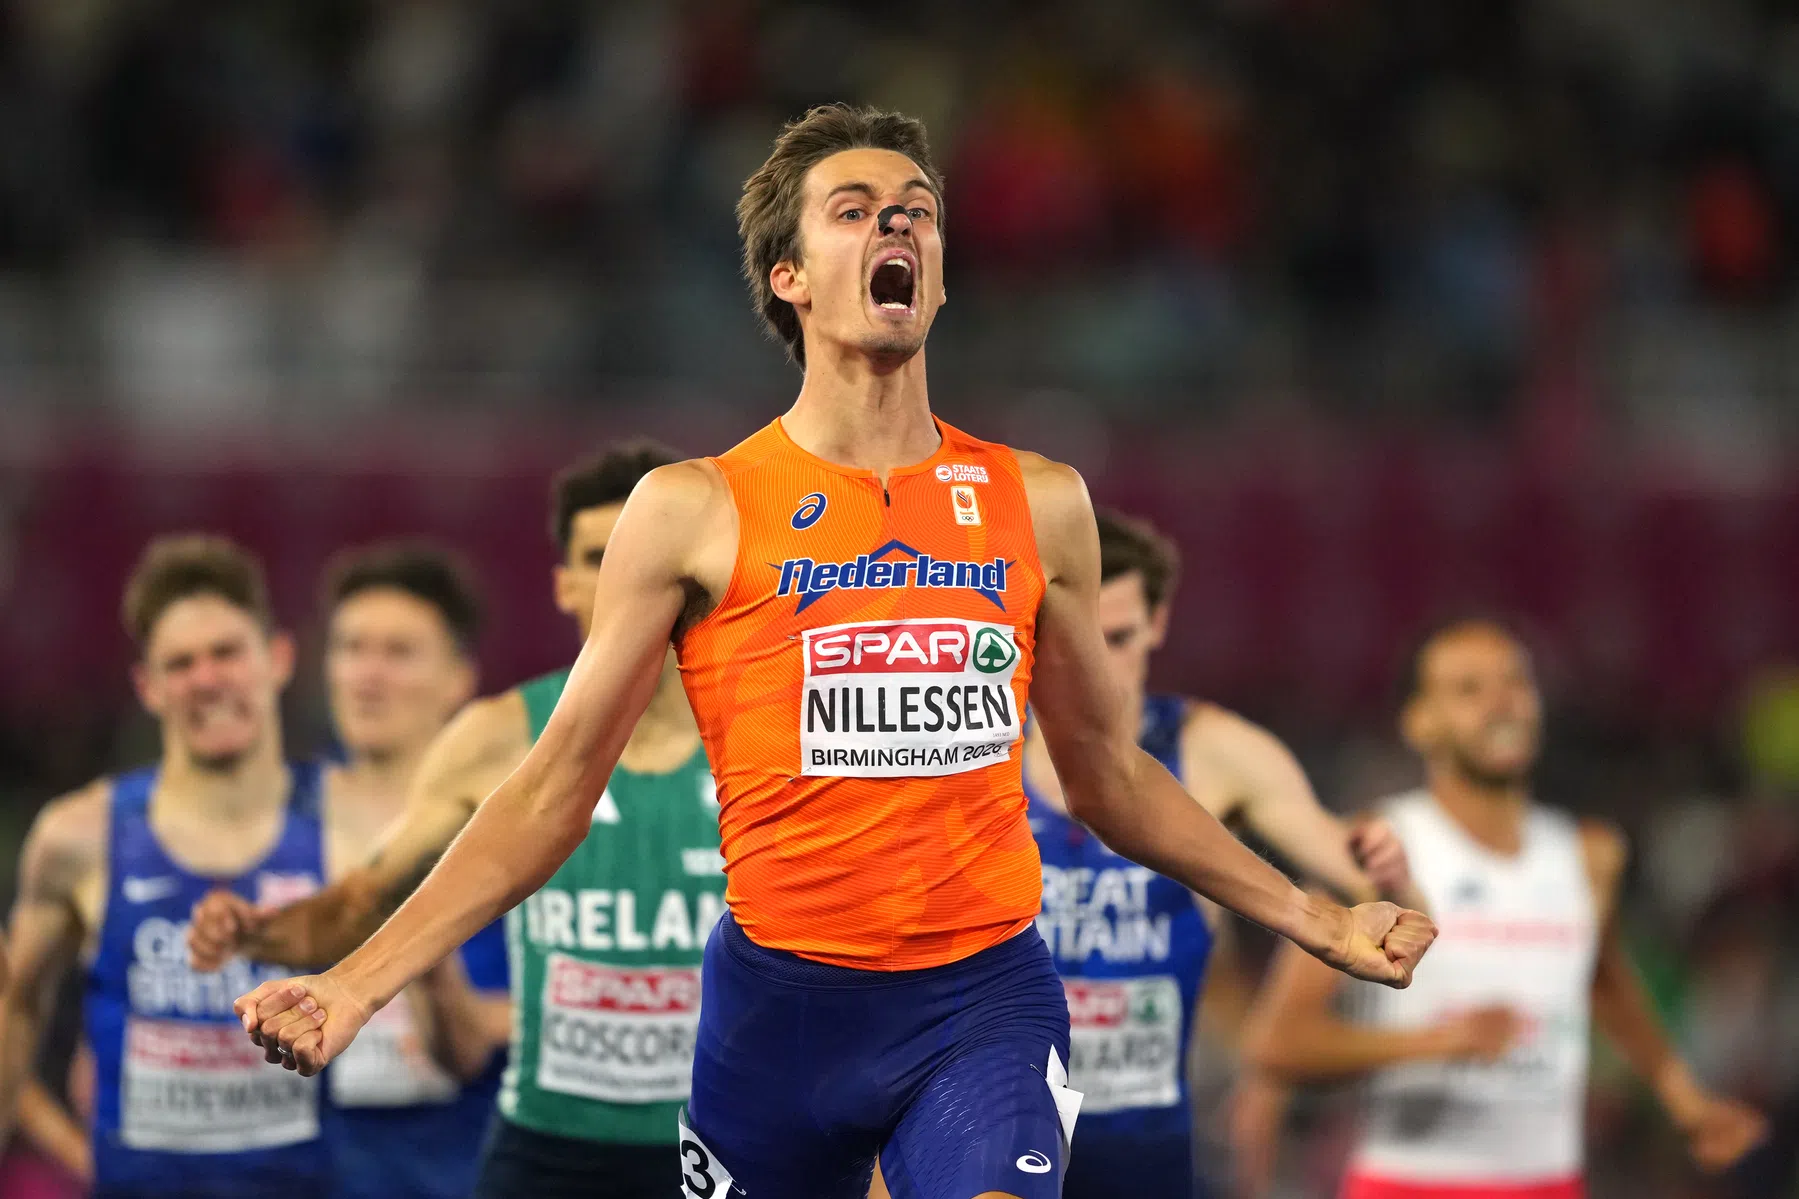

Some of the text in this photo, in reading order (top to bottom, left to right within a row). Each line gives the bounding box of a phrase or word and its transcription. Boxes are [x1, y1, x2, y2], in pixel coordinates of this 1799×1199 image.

[952, 464, 987, 475] STAATS
[814, 631, 966, 668] SPAR
[807, 685, 1012, 732] NILLESSEN
[812, 742, 1006, 766] BIRMINGHAM 2026
[1041, 864, 1156, 914] REAT
[681, 1140, 716, 1199] 3
